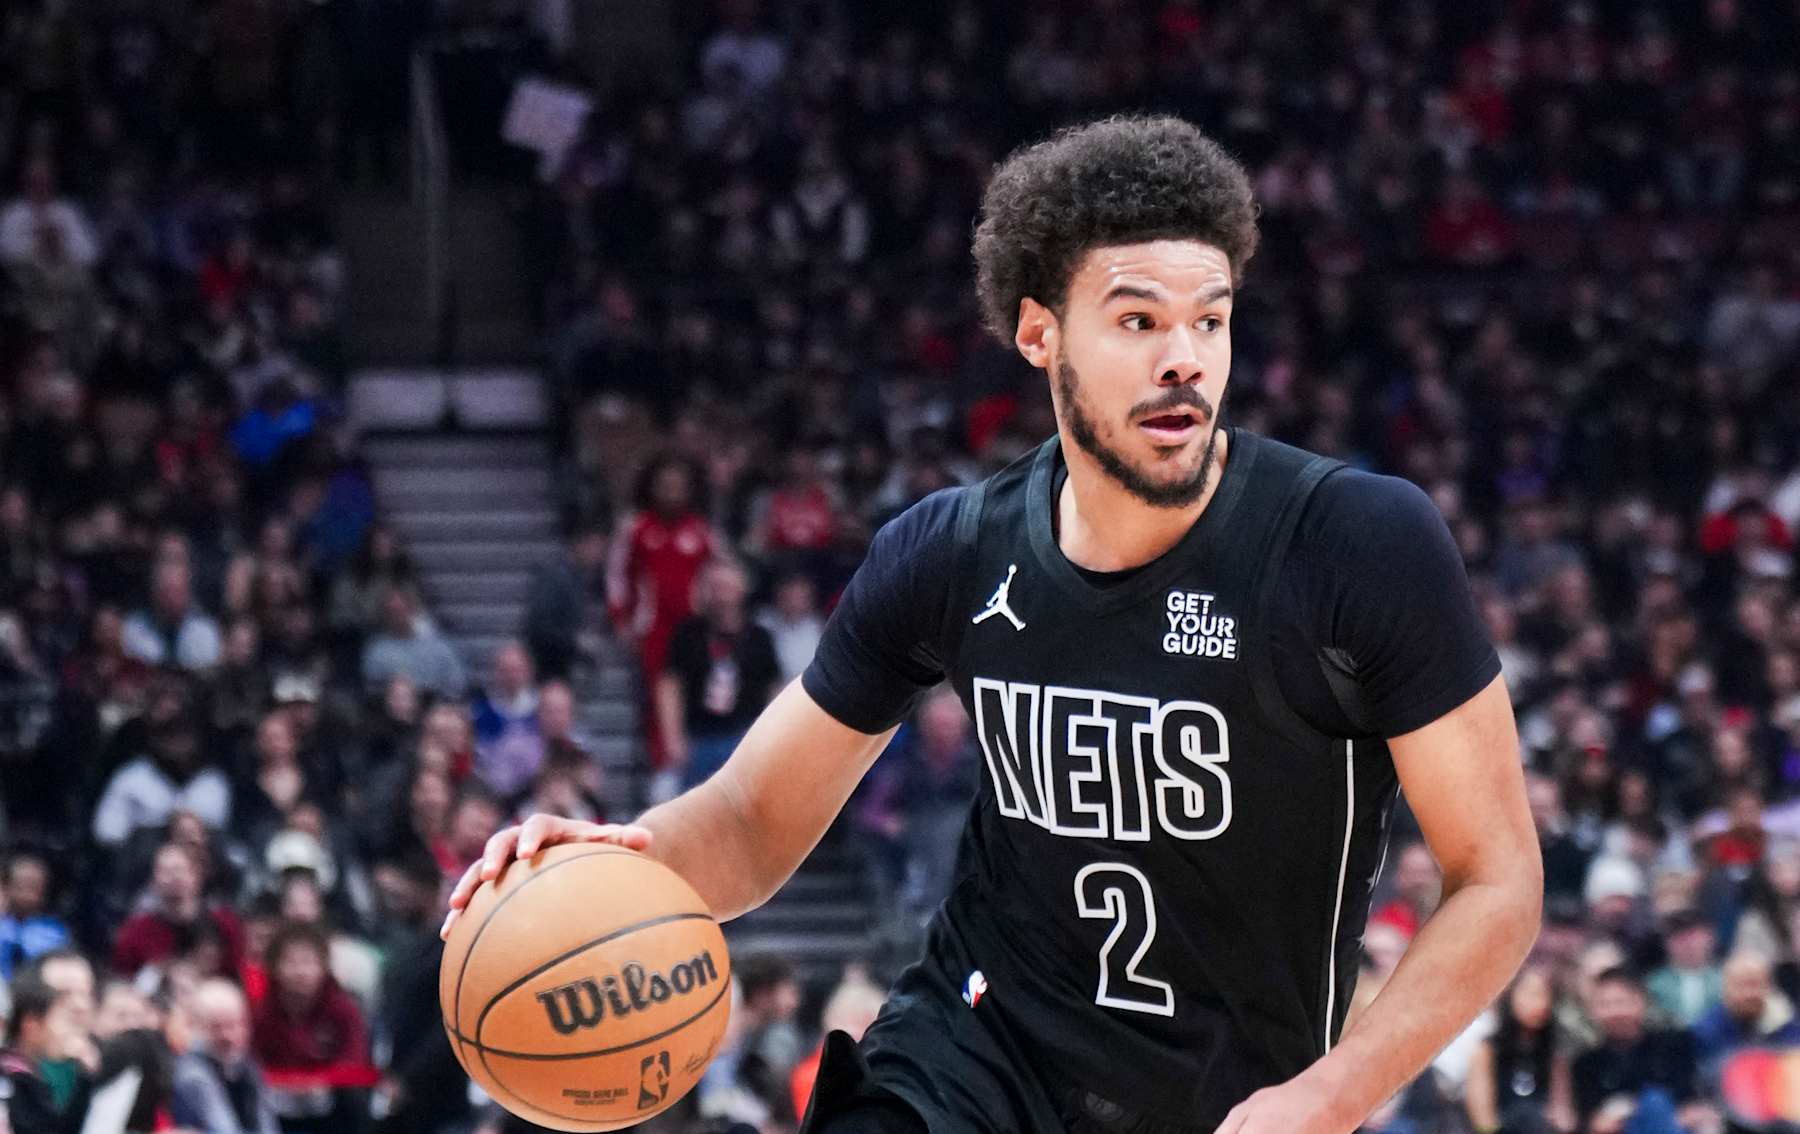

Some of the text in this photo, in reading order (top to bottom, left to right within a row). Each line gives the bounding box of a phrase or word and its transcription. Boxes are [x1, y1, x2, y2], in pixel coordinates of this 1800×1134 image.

[1166, 591, 1214, 615] GET
[1166, 611, 1235, 638] YOUR
[1162, 632, 1237, 659] GUIDE
[973, 677, 1232, 842] NETS
[1074, 862, 1175, 1018] 2
[536, 949, 718, 1035] Wilson
